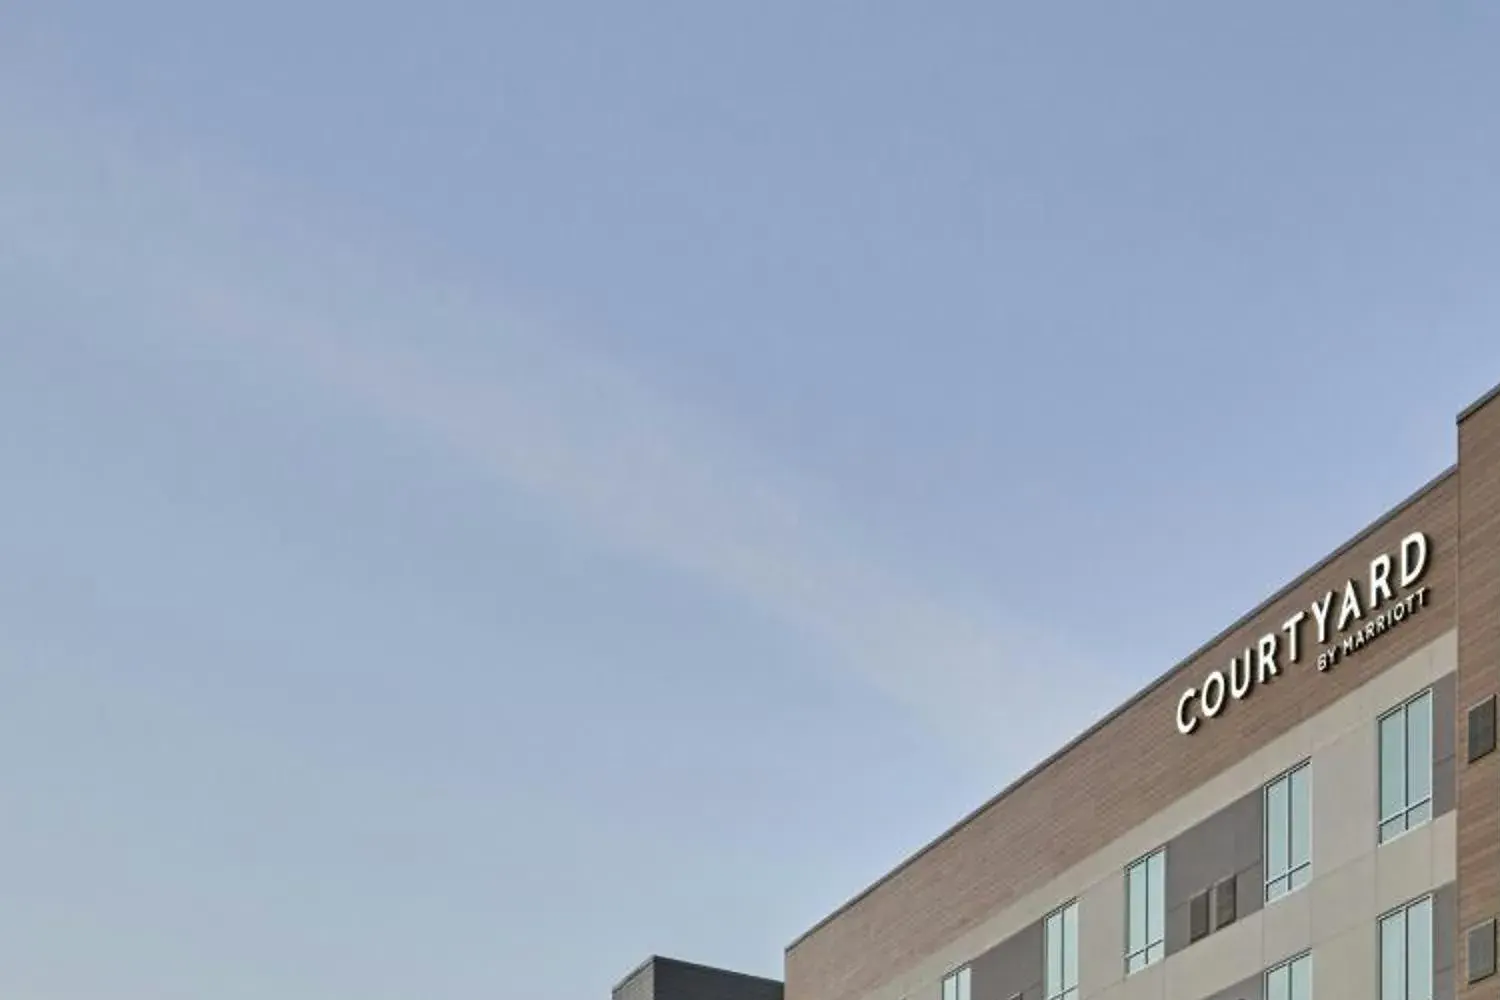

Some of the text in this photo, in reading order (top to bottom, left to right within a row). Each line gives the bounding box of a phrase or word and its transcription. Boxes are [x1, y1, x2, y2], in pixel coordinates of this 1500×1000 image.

[1176, 531, 1428, 734] COURTYARD
[1317, 586, 1428, 671] BY MARRIOTT
